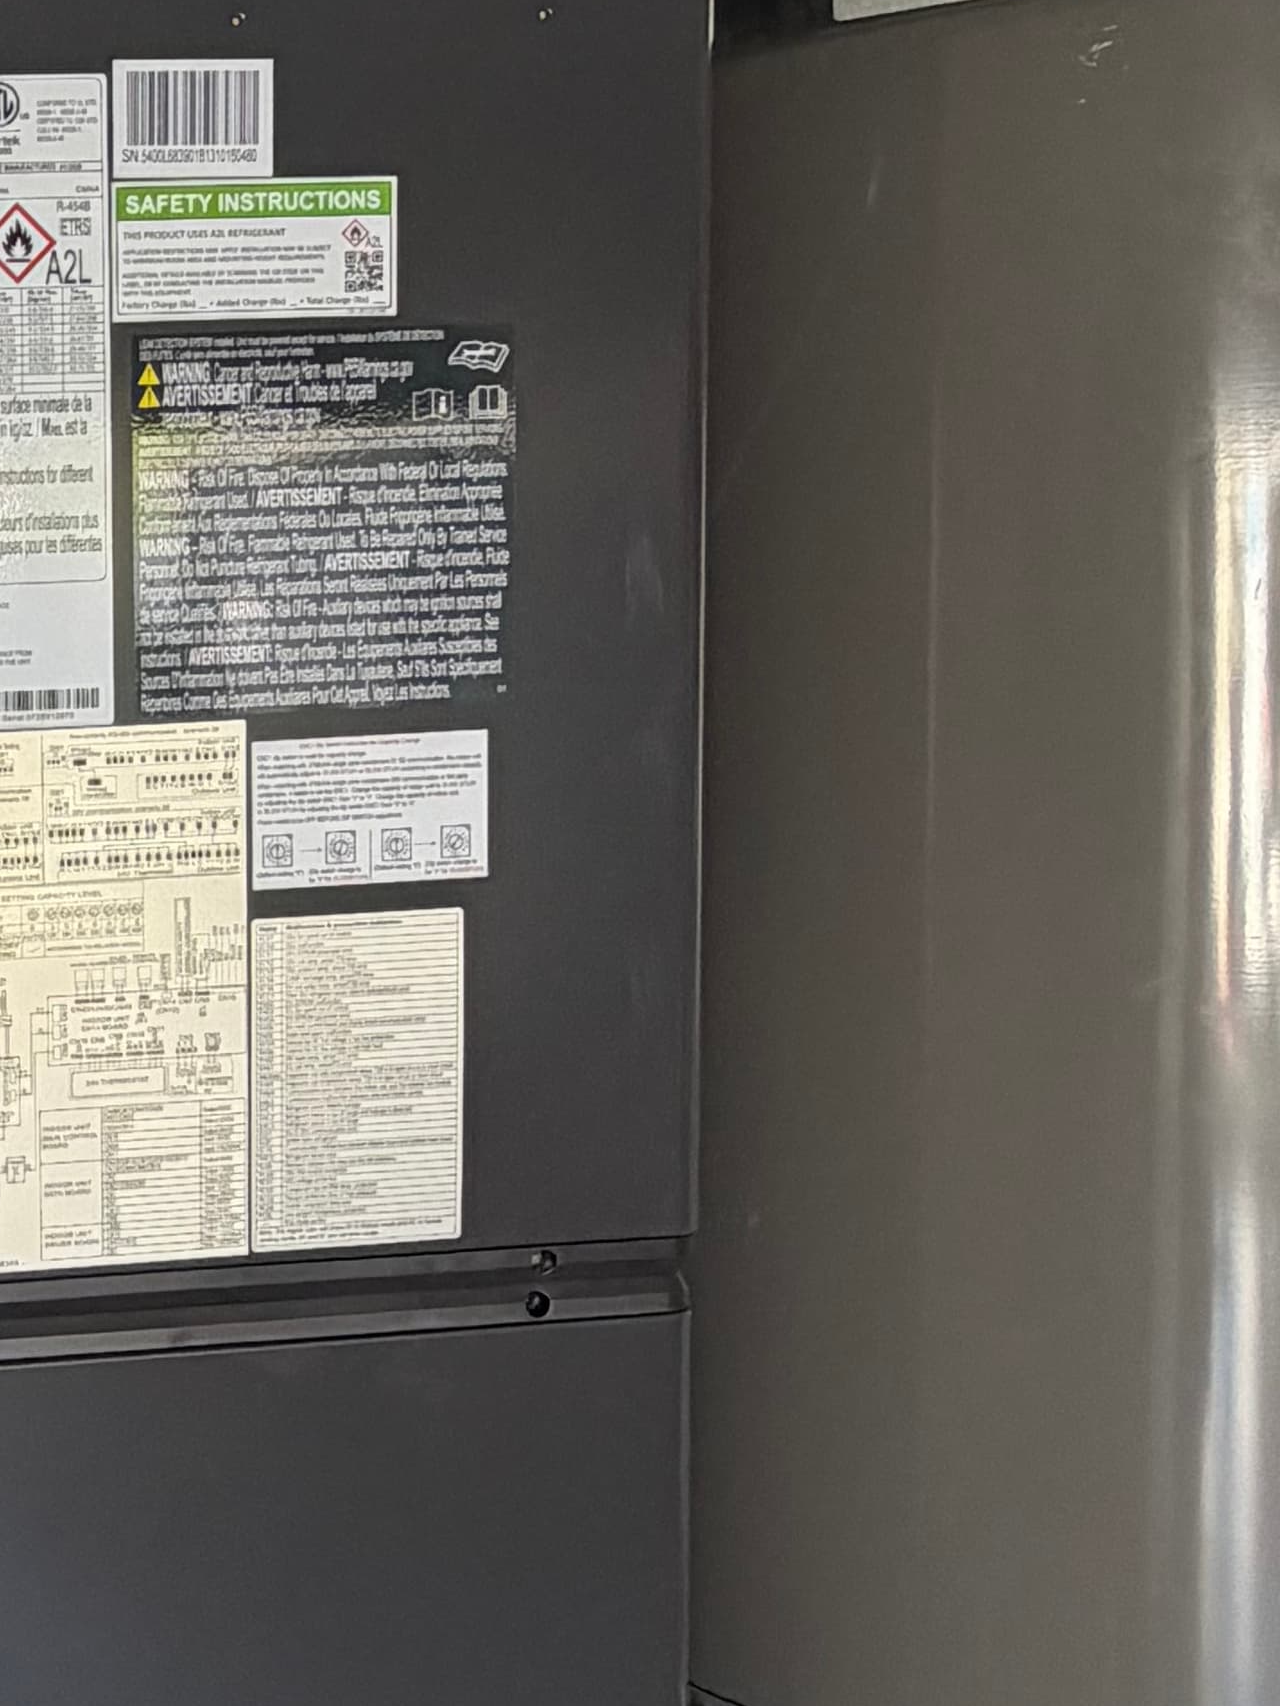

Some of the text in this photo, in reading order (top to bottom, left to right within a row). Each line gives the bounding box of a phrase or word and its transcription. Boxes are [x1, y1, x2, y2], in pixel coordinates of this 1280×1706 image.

[56, 200, 91, 213] R-454B
[125, 189, 382, 215] SAFETY INSTRUCTIONS
[144, 230, 186, 240] PRODUCT
[45, 248, 93, 284] A2L
